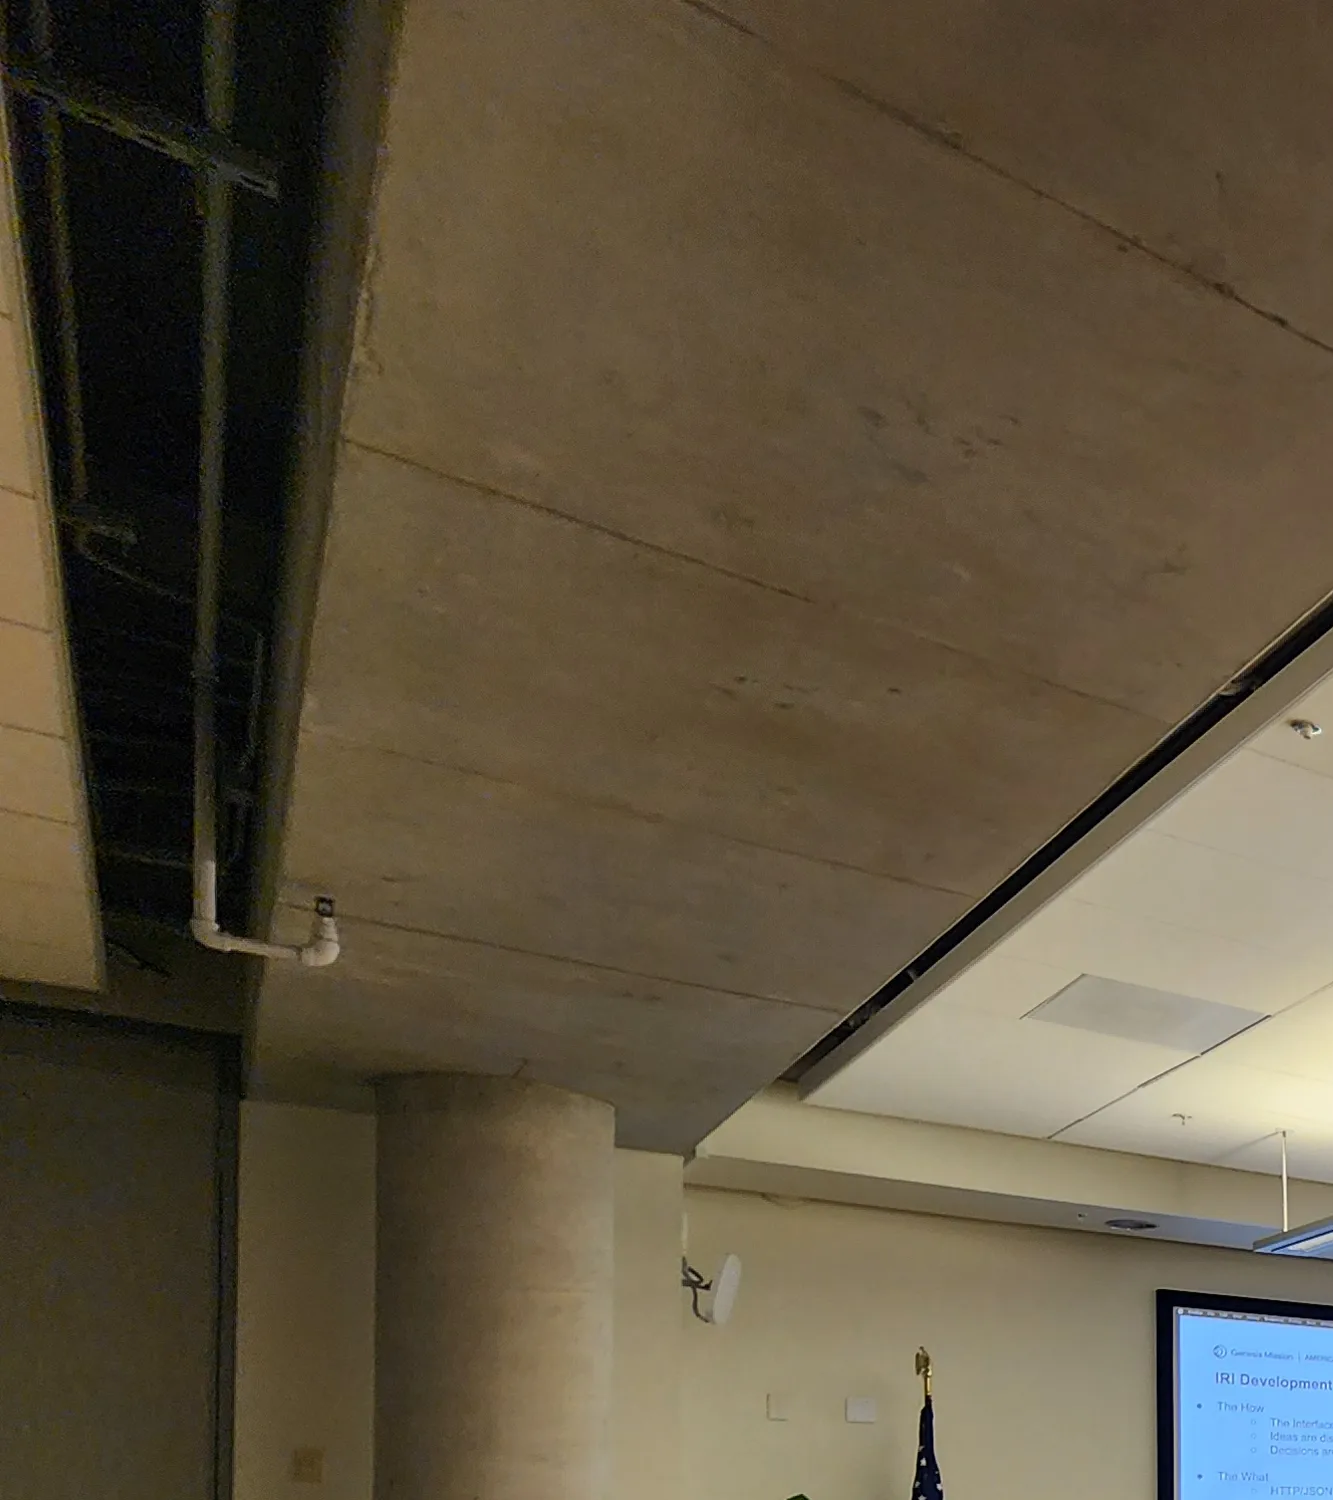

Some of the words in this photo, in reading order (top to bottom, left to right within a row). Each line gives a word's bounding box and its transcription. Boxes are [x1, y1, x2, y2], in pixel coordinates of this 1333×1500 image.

[1215, 1372, 1234, 1384] IRI
[1240, 1373, 1332, 1391] Development
[1218, 1402, 1238, 1412] The
[1241, 1403, 1265, 1413] How
[1271, 1418, 1290, 1427] The
[1271, 1431, 1298, 1442] Ideas
[1301, 1434, 1317, 1442] are
[1270, 1446, 1319, 1456] Decisions
[1218, 1472, 1238, 1481] The
[1241, 1472, 1269, 1482] What
[1271, 1486, 1332, 1496] HTTP/JSON
